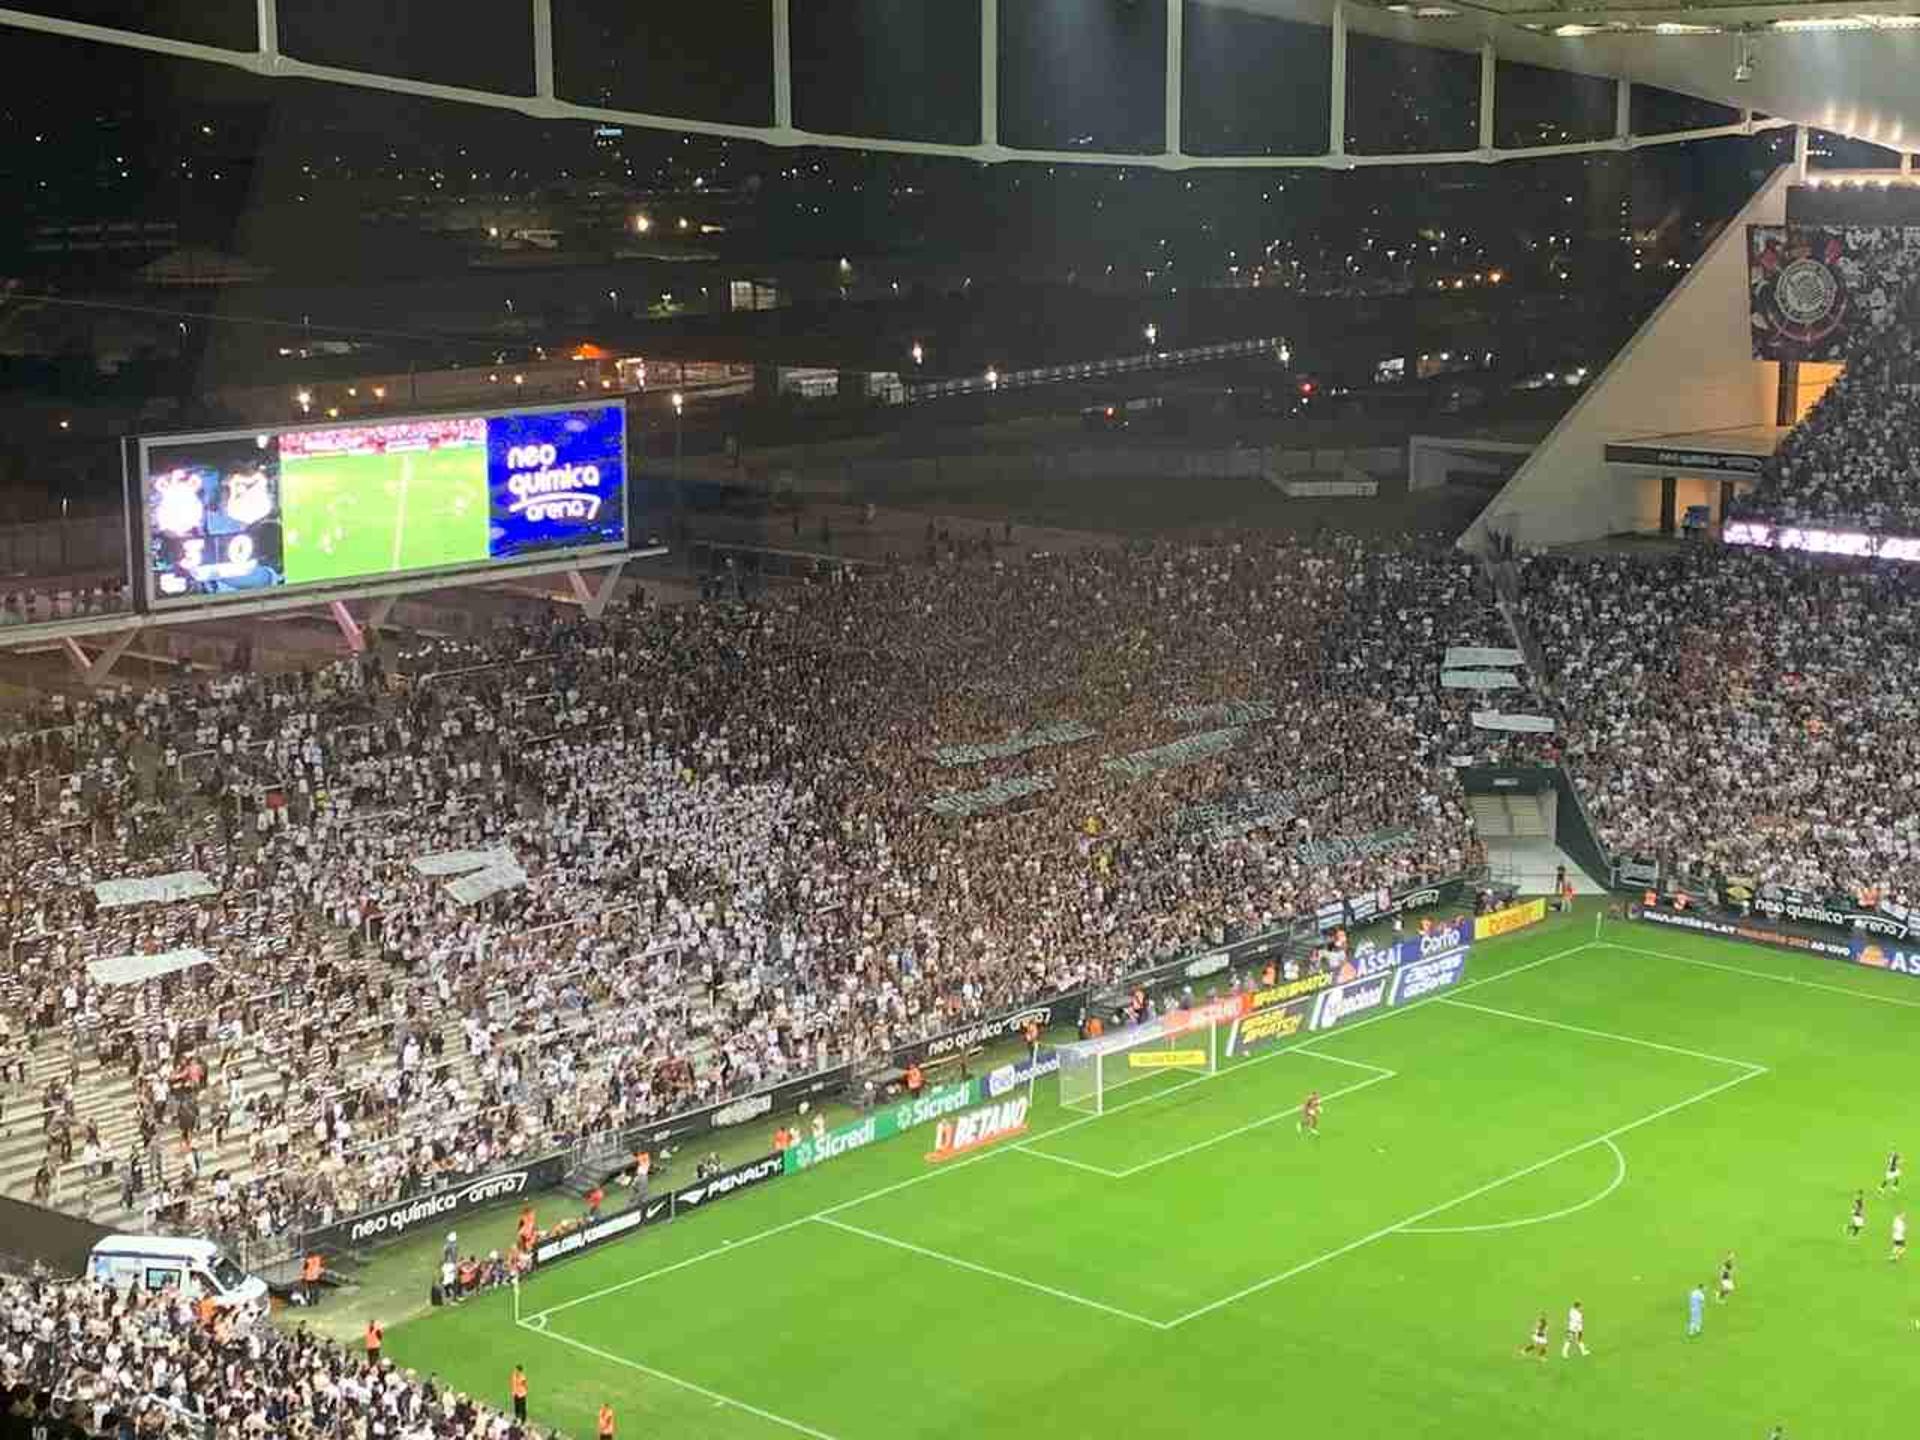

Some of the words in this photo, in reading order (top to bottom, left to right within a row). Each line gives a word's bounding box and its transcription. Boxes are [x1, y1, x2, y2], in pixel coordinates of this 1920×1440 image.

[507, 443, 557, 470] neo
[508, 462, 600, 503] química
[911, 1083, 969, 1125] Sicredi
[953, 1095, 1029, 1149] BETANO
[812, 1116, 875, 1160] Sicredi
[708, 1158, 782, 1197] PENALTY
[352, 1216, 388, 1241] neo
[390, 1194, 457, 1232] química
